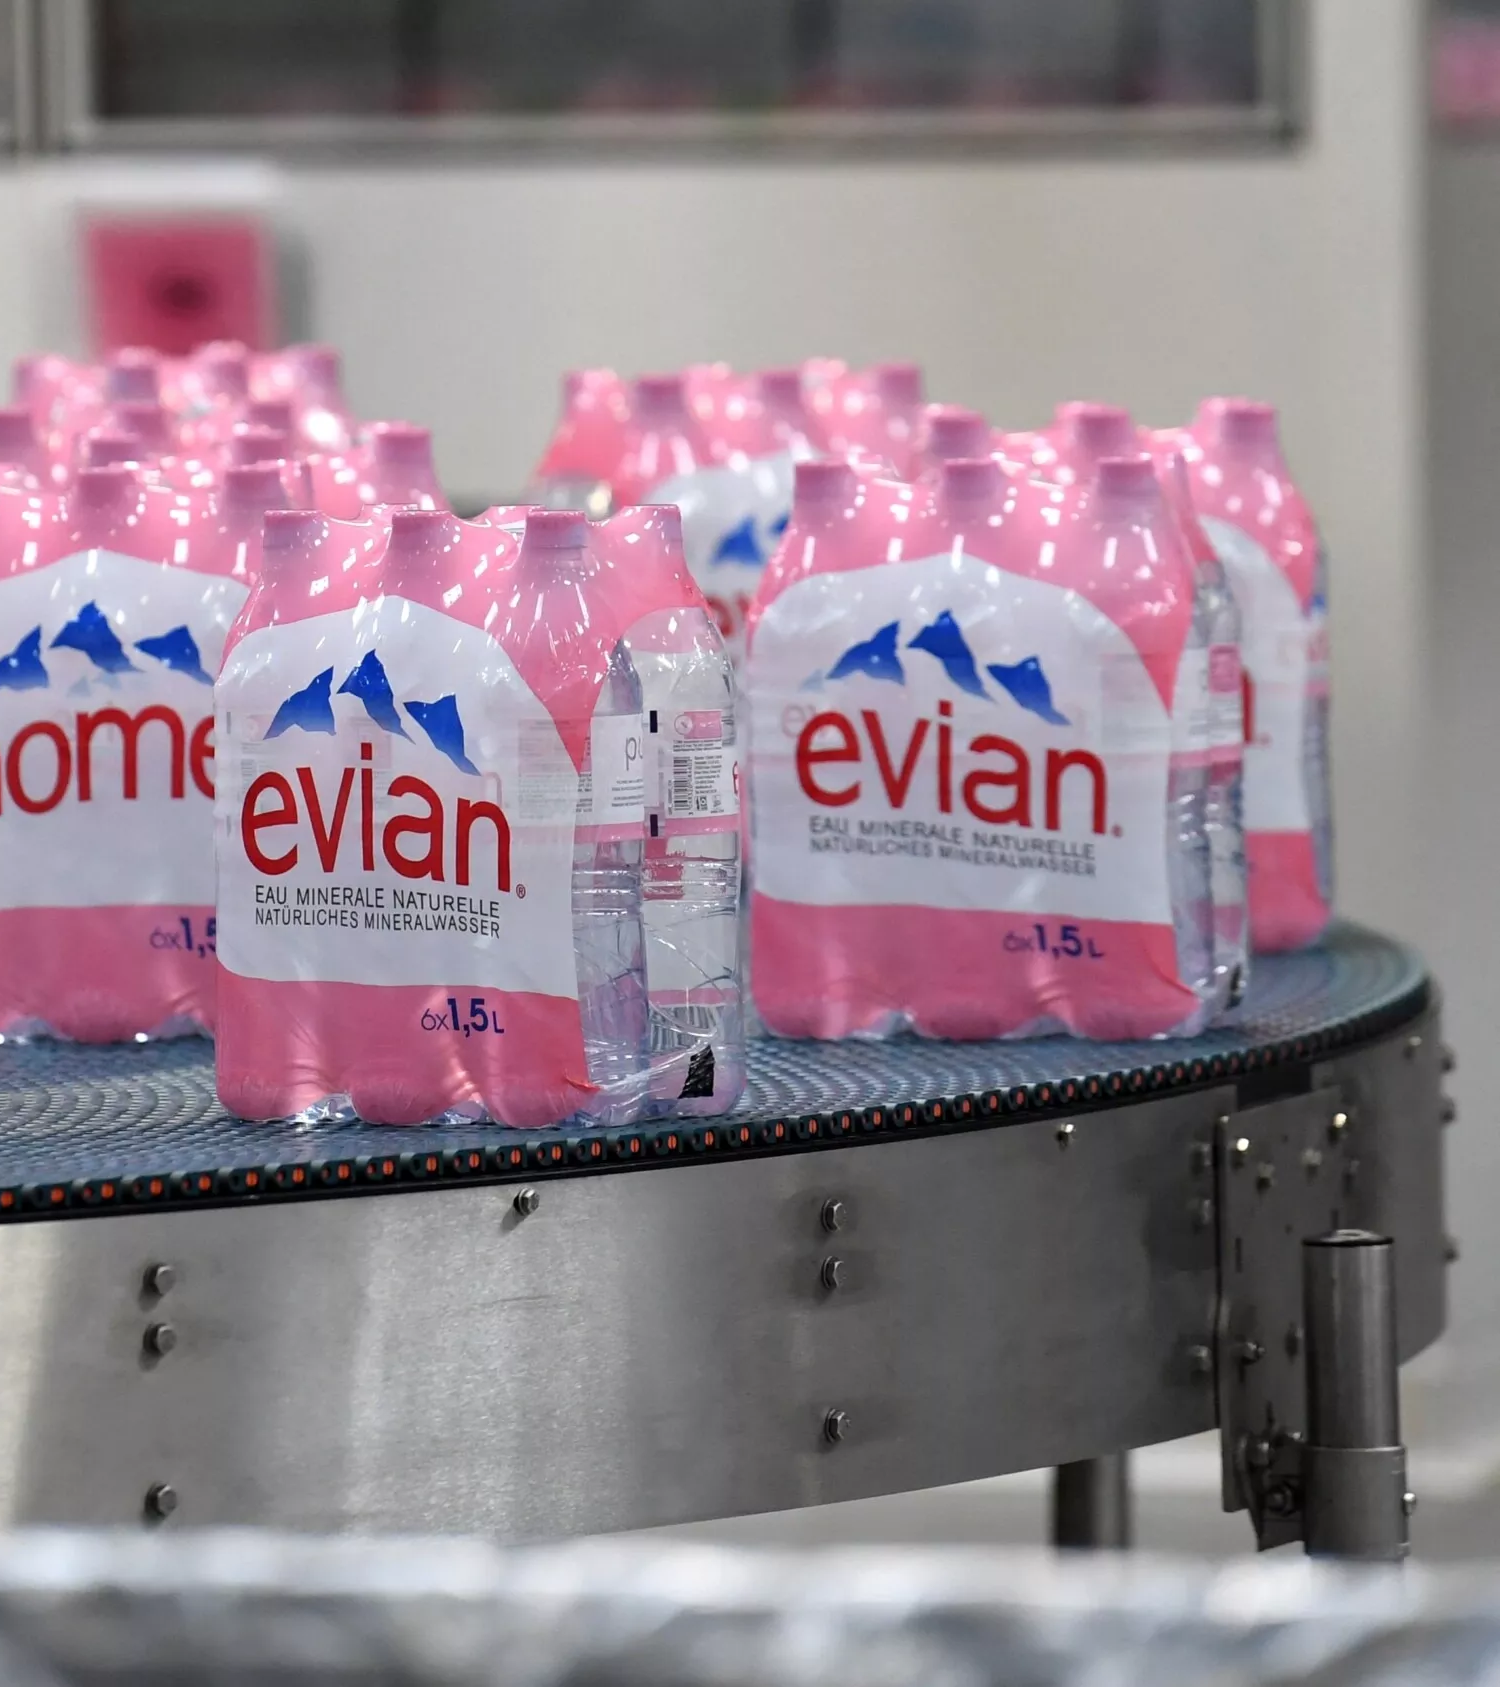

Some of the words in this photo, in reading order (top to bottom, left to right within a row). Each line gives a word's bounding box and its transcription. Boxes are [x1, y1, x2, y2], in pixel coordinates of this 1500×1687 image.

[795, 699, 1108, 836] evian
[241, 742, 511, 894] evian
[809, 816, 849, 835] EAU
[858, 819, 964, 846] MINERALE
[972, 830, 1096, 861] NATURELLE
[255, 885, 288, 905] EAU
[296, 887, 385, 909] MINERALE
[393, 889, 500, 919] NATURELLE
[255, 905, 359, 929] NATÜRLICHES
[364, 912, 500, 939] MINERALWASSER
